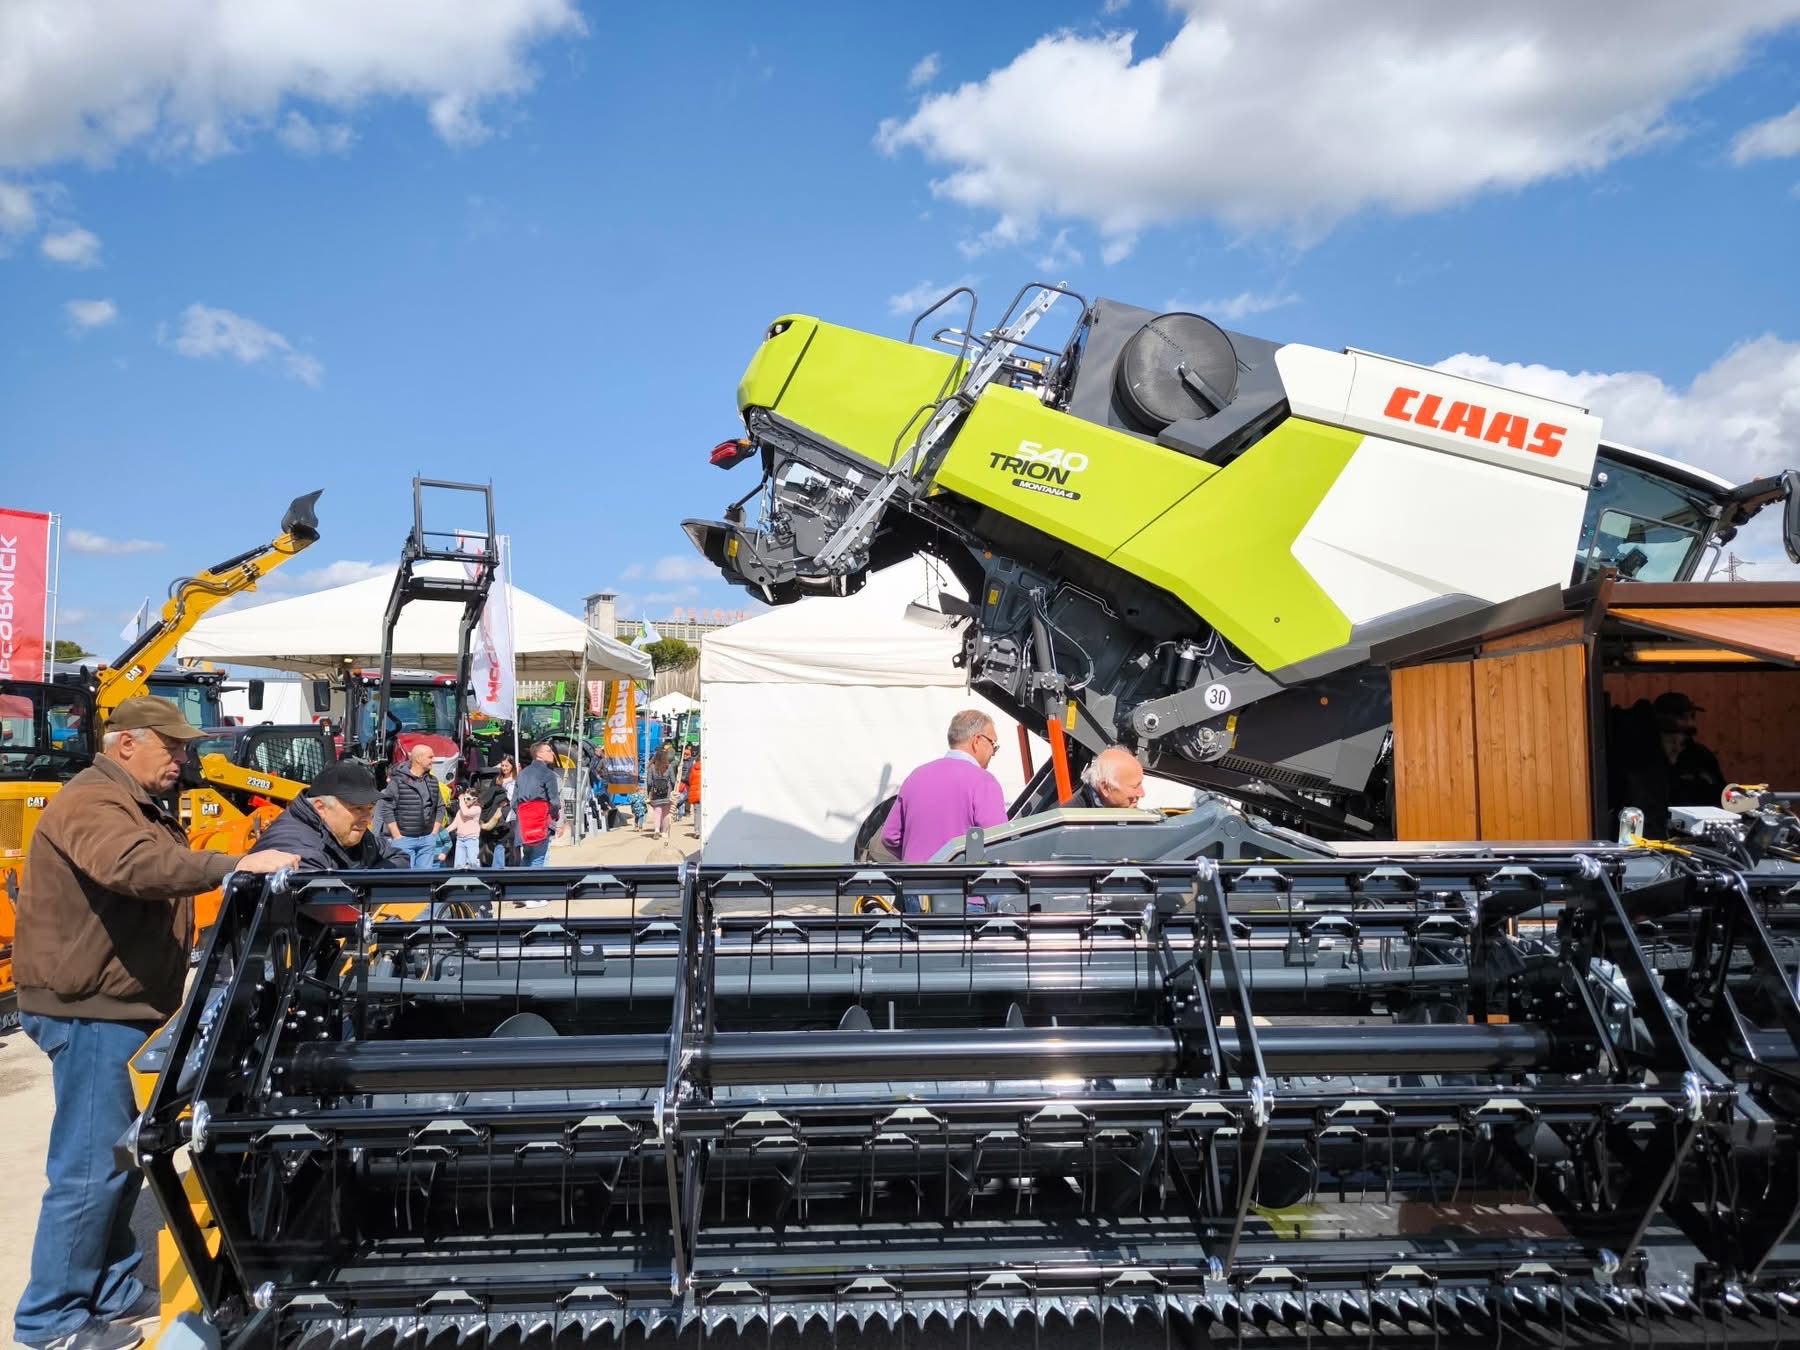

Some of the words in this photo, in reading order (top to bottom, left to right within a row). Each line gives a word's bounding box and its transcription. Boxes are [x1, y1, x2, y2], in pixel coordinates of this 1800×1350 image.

[1384, 387, 1568, 458] CLAAS
[1014, 439, 1089, 473] 540
[989, 452, 1071, 485] TRION
[1019, 480, 1065, 497] MONTANA
[126, 665, 142, 681] CAT
[1209, 688, 1226, 705] 30
[27, 797, 45, 808] CAT
[202, 803, 219, 815] CAT
